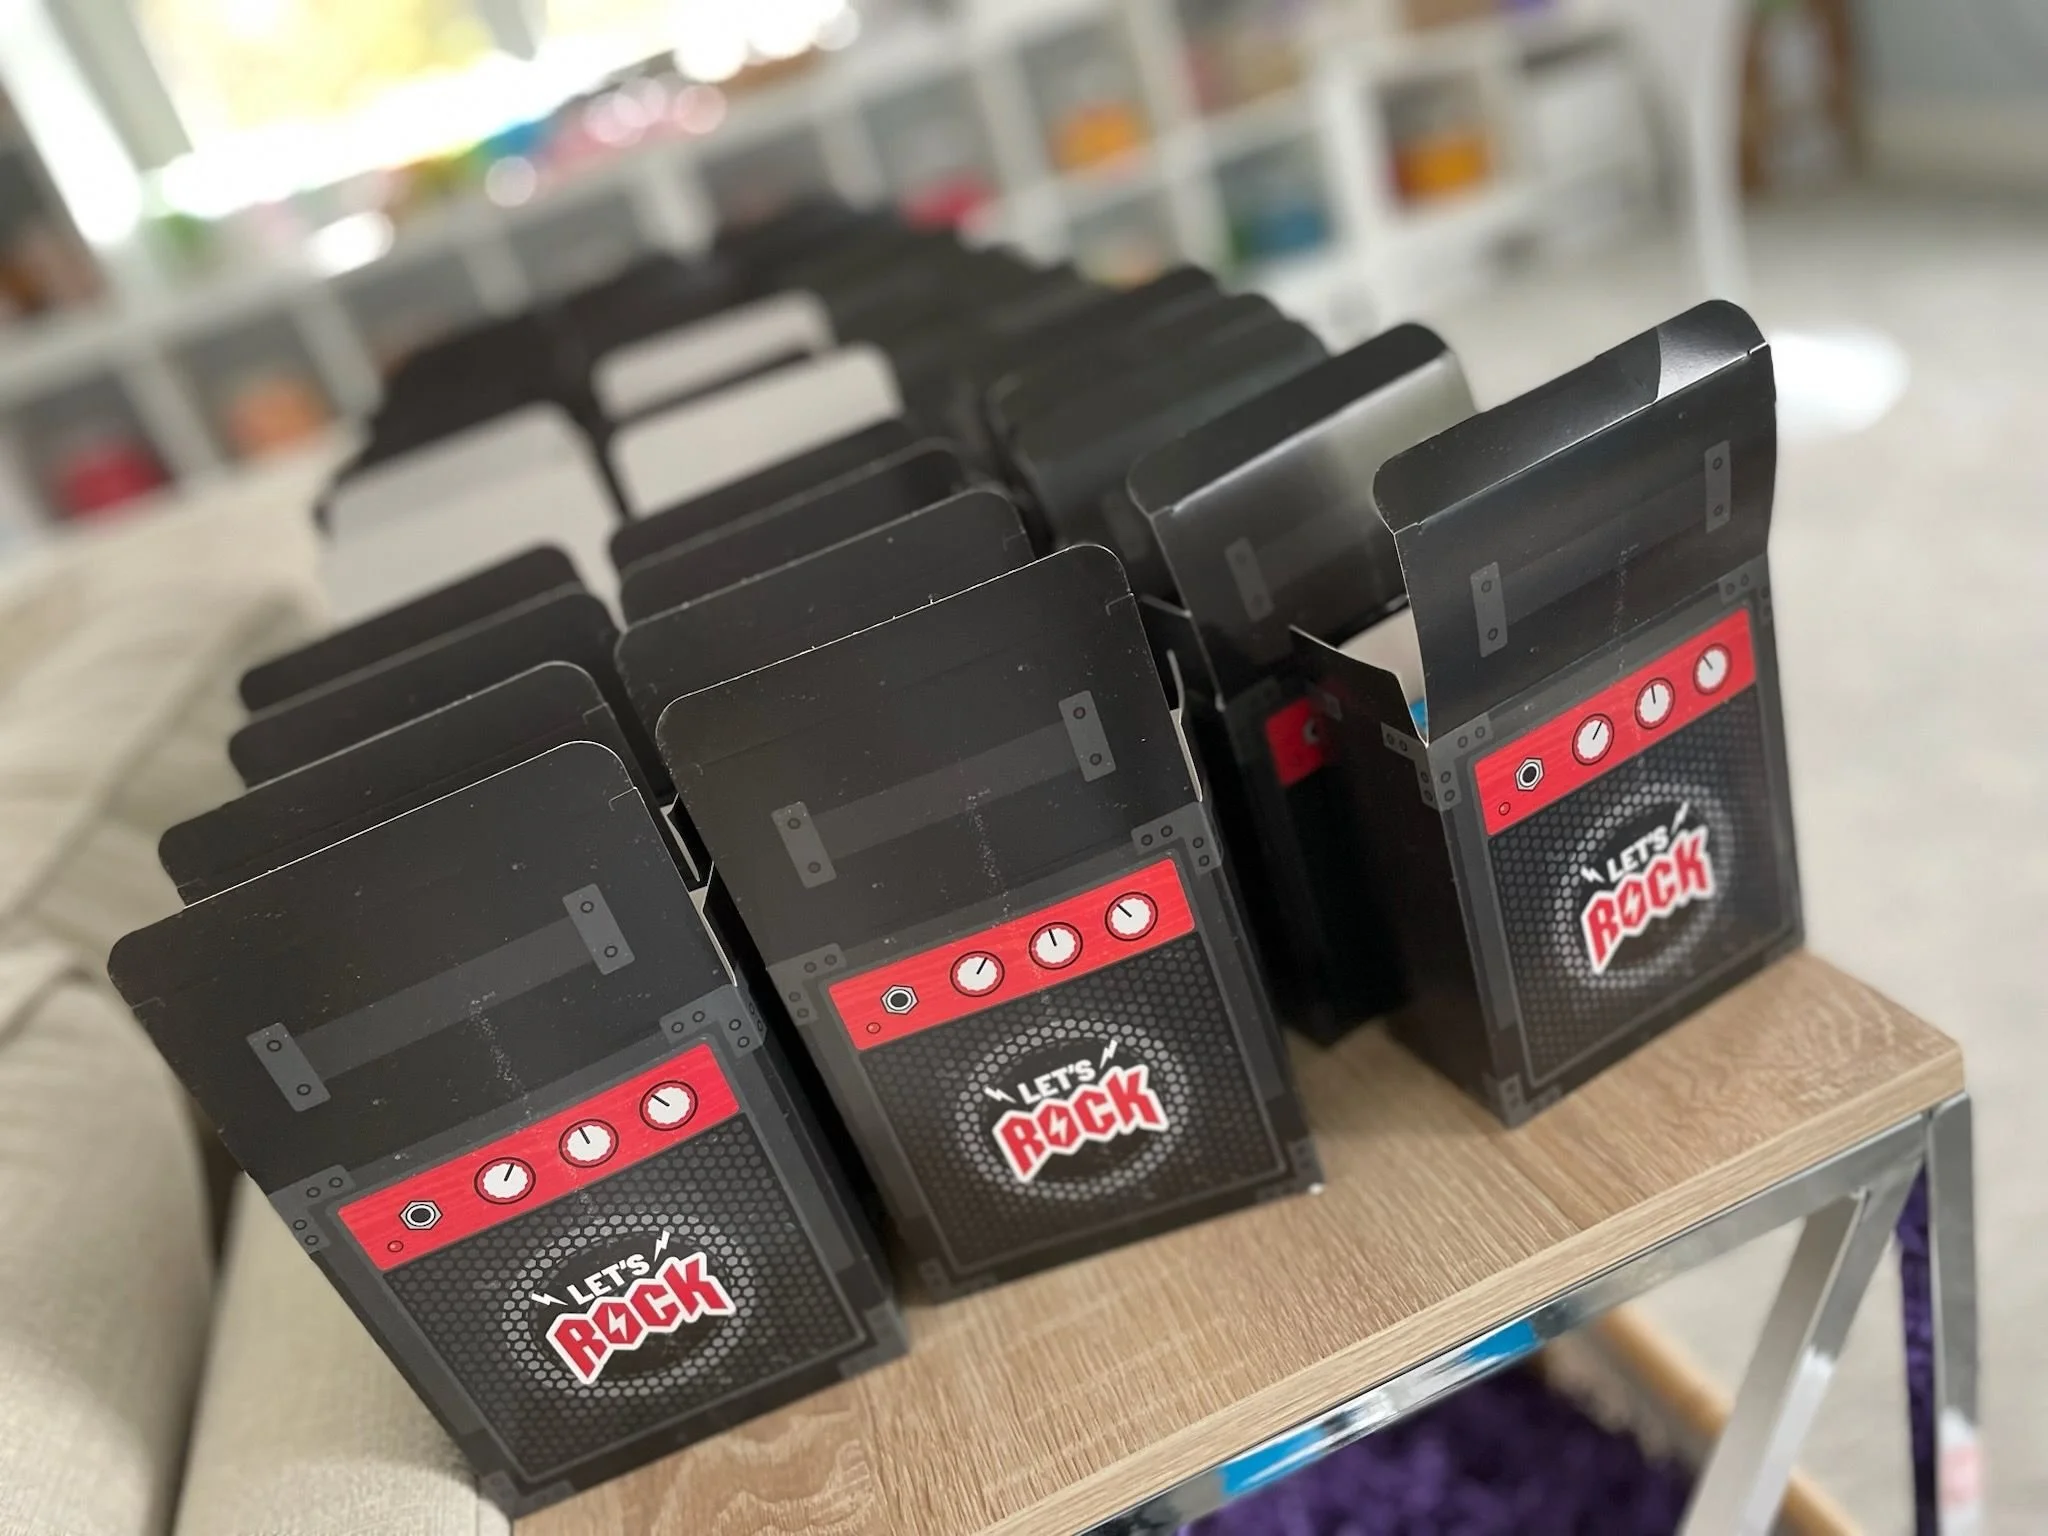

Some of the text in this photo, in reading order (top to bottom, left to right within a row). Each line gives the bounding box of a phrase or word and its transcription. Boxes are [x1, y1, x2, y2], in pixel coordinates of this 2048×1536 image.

[1582, 826, 1715, 973] ROCK
[993, 1064, 1169, 1181] ROCK
[1018, 1059, 1096, 1105] LET'S
[546, 1252, 736, 1384] ROCK
[566, 1254, 650, 1305] LET'S
